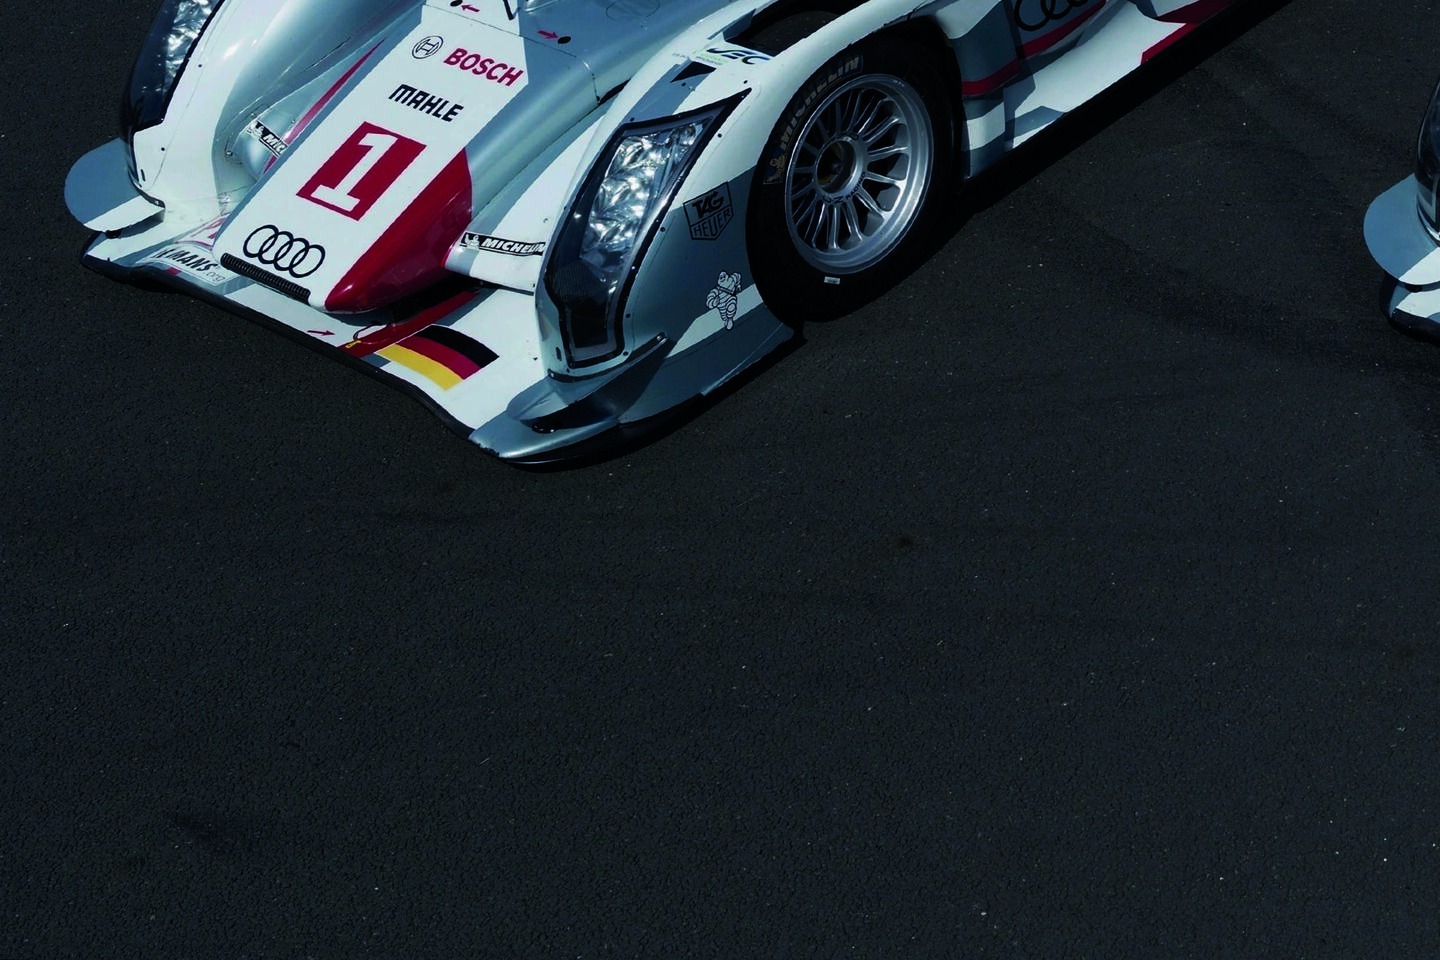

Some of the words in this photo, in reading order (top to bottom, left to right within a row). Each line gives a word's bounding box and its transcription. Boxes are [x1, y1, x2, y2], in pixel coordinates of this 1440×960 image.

[443, 47, 524, 86] BOSCH
[388, 83, 464, 122] MAHLE
[310, 132, 399, 213] 1
[692, 191, 725, 218] TAG
[692, 209, 732, 239] HEUER
[480, 237, 545, 253] MICHELIN
